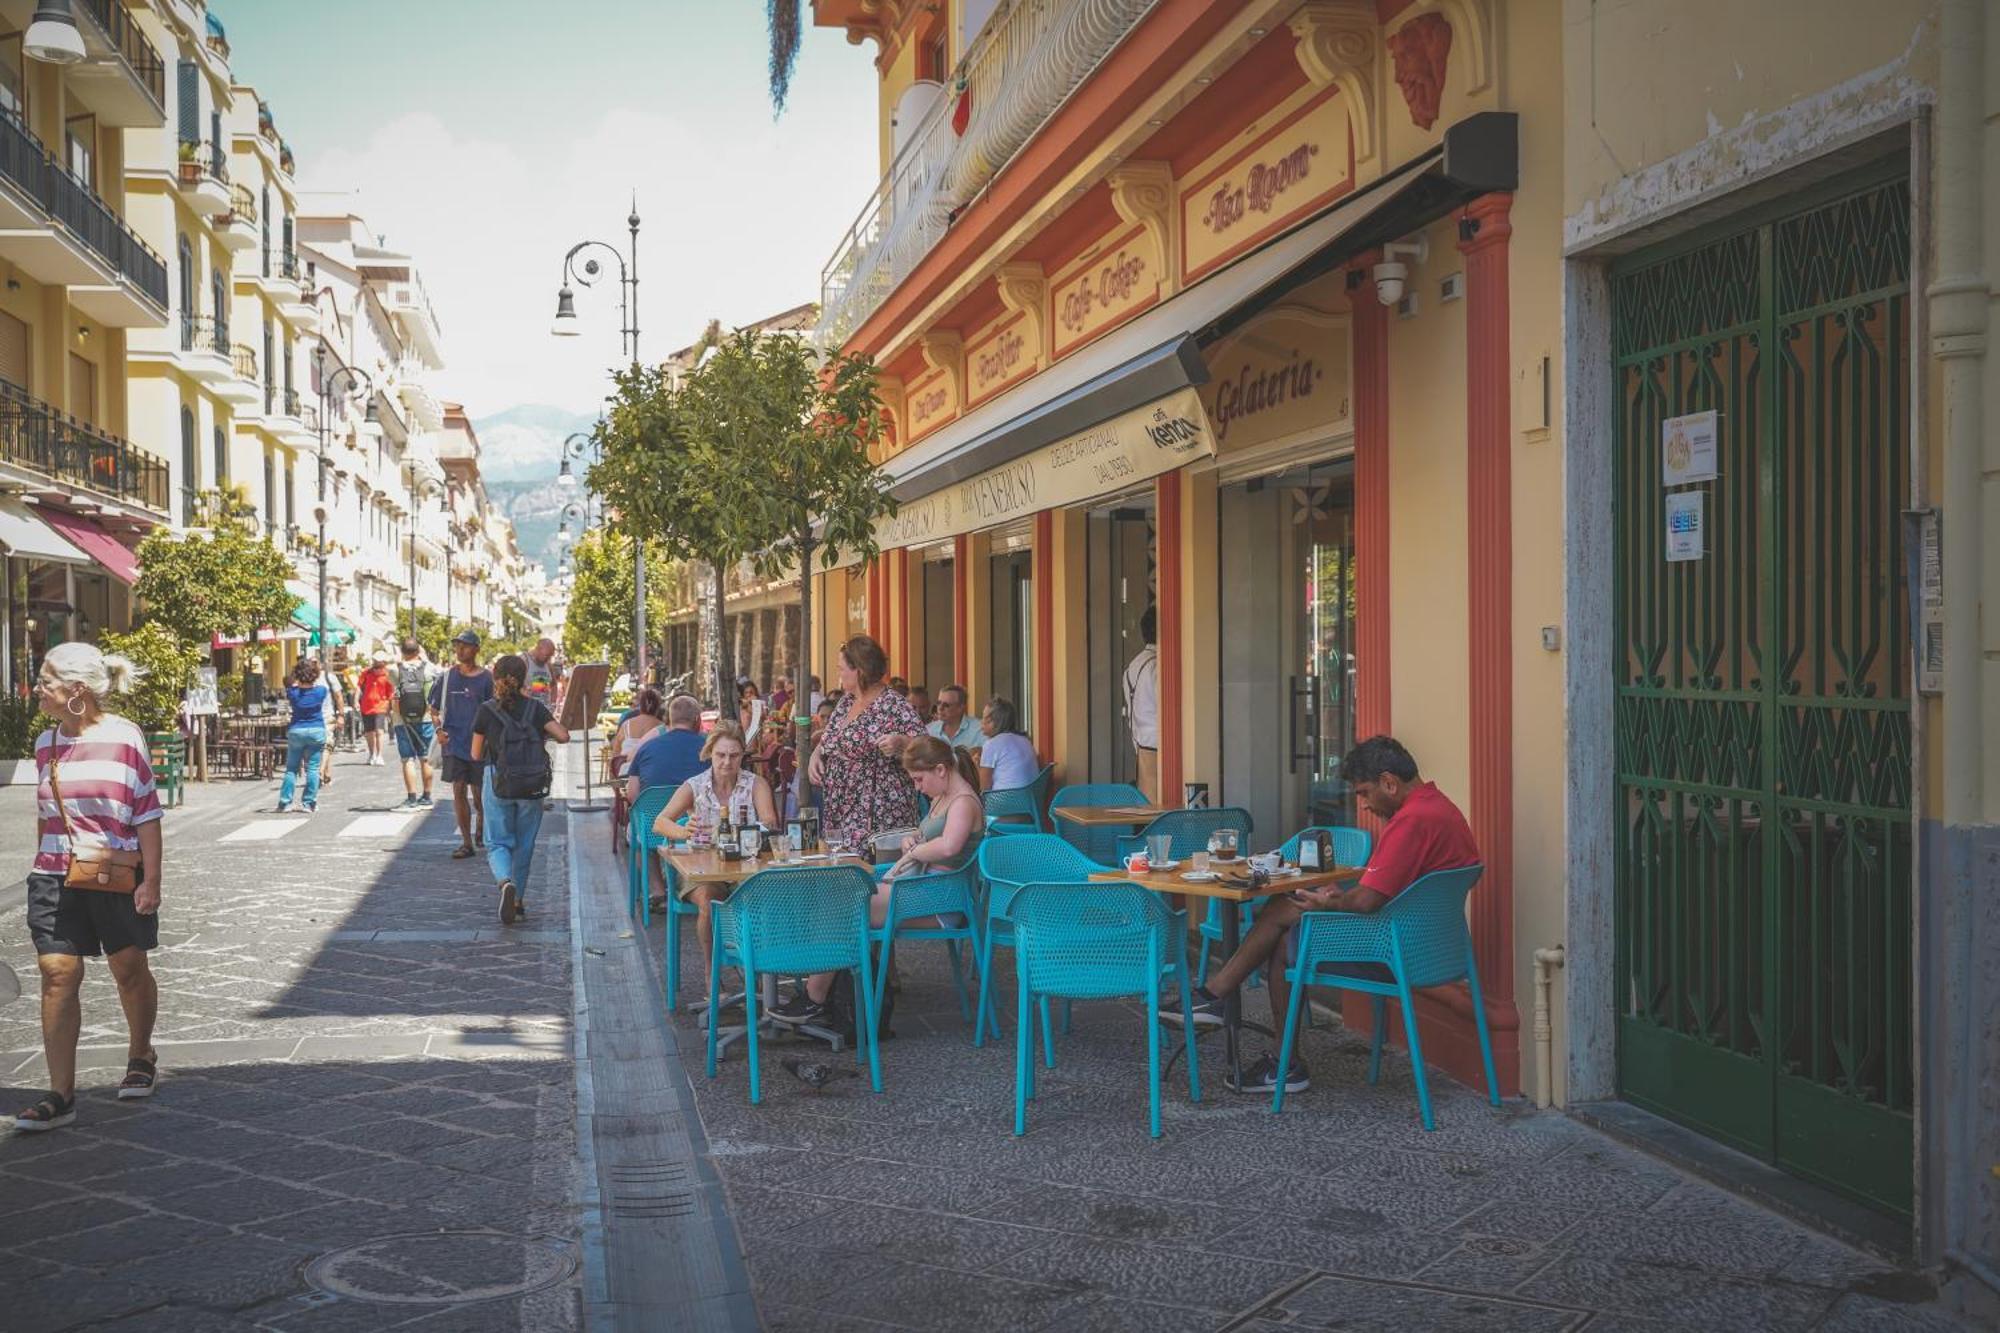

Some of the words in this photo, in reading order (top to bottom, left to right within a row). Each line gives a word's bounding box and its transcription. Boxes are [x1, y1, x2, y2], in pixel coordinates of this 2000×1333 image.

[1247, 143, 1310, 213] Room
[1215, 349, 1313, 440] Gelateria
[972, 460, 1036, 519] VENERUSO
